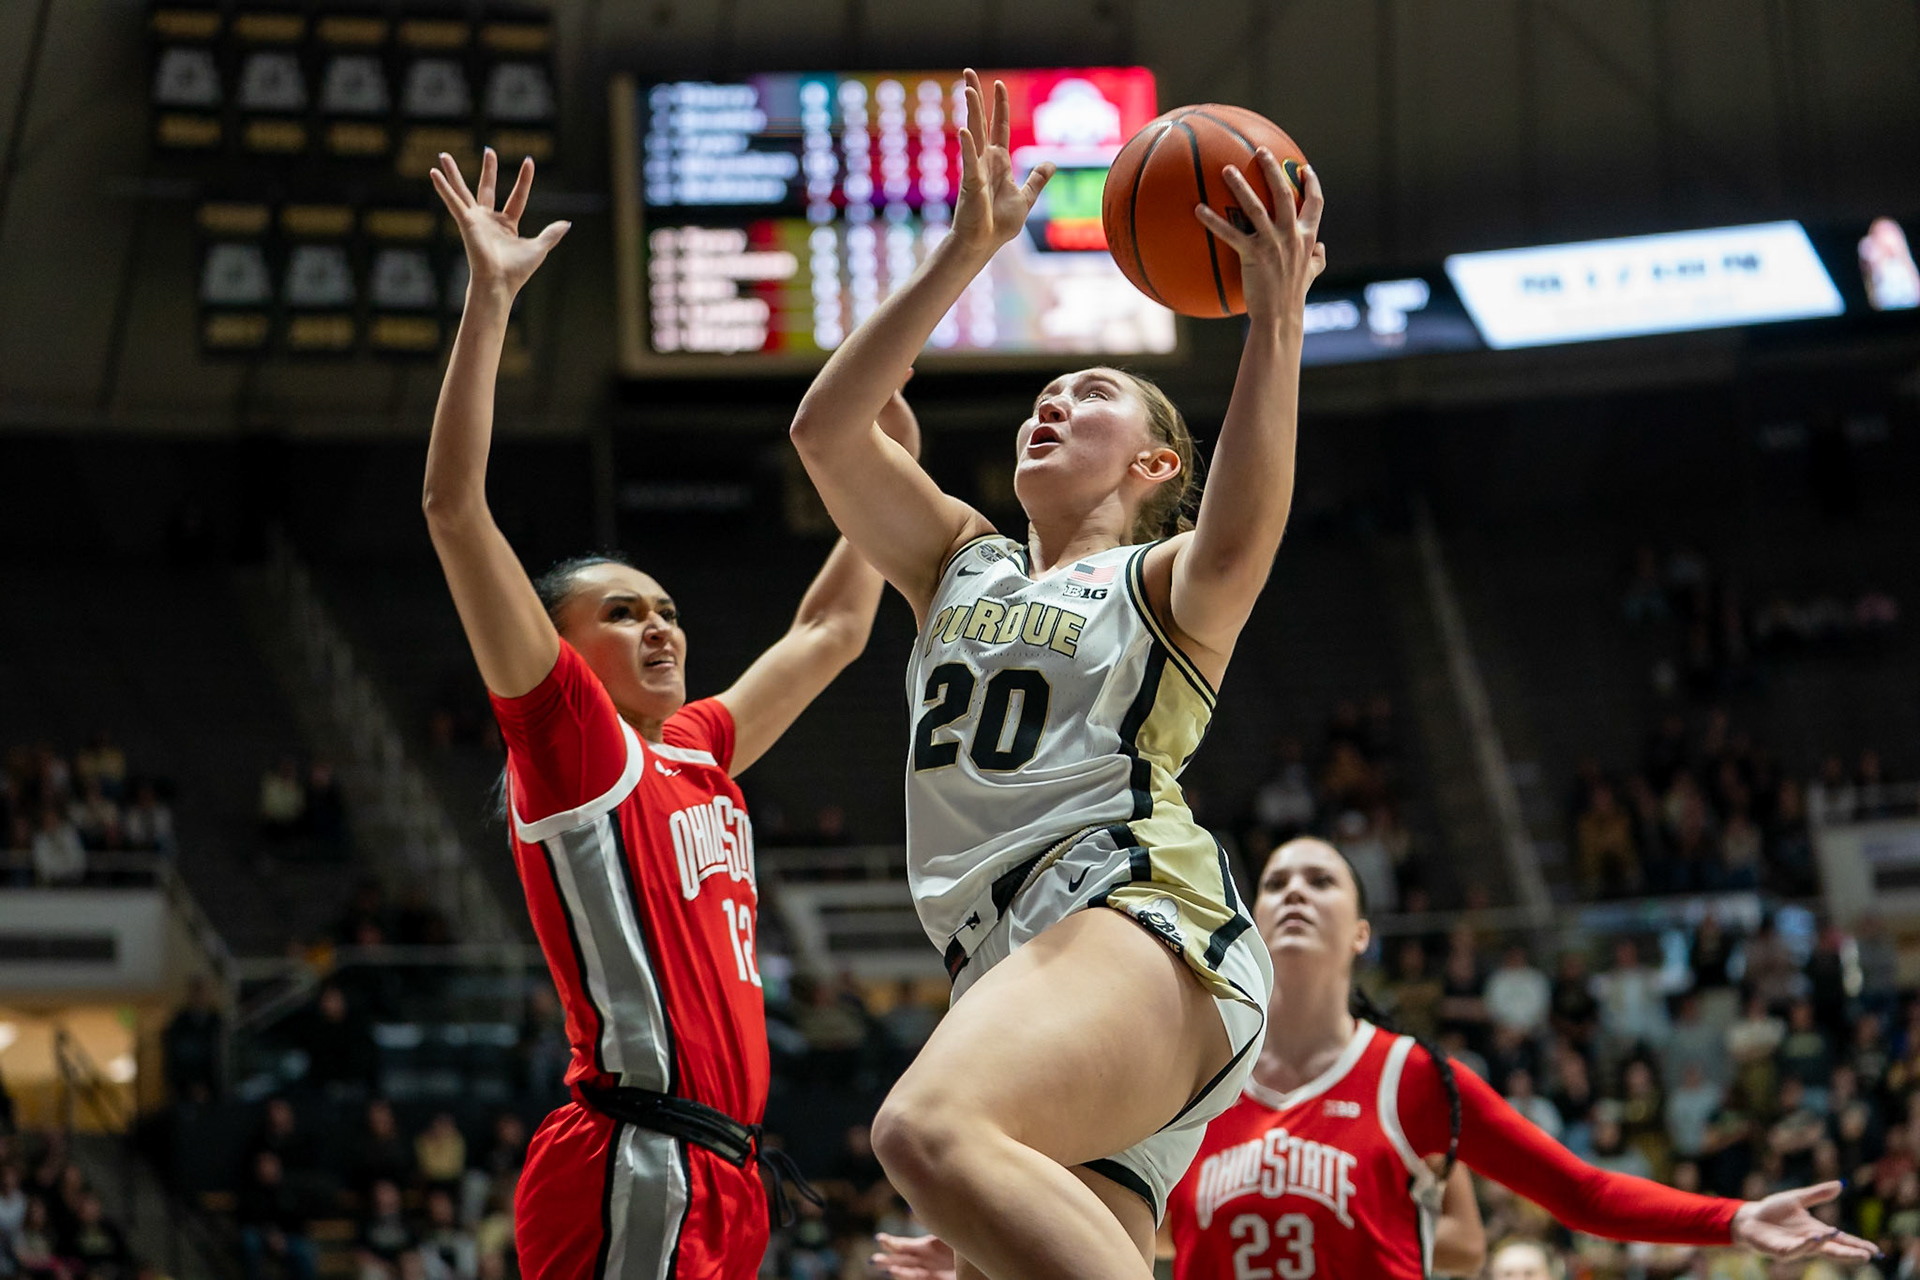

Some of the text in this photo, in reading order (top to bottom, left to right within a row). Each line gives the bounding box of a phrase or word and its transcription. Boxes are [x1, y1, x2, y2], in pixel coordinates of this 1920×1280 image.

[925, 598, 1087, 658] PURDUE
[913, 661, 1050, 774] 20
[723, 899, 762, 986] 12
[1229, 1213, 1316, 1280] 23
